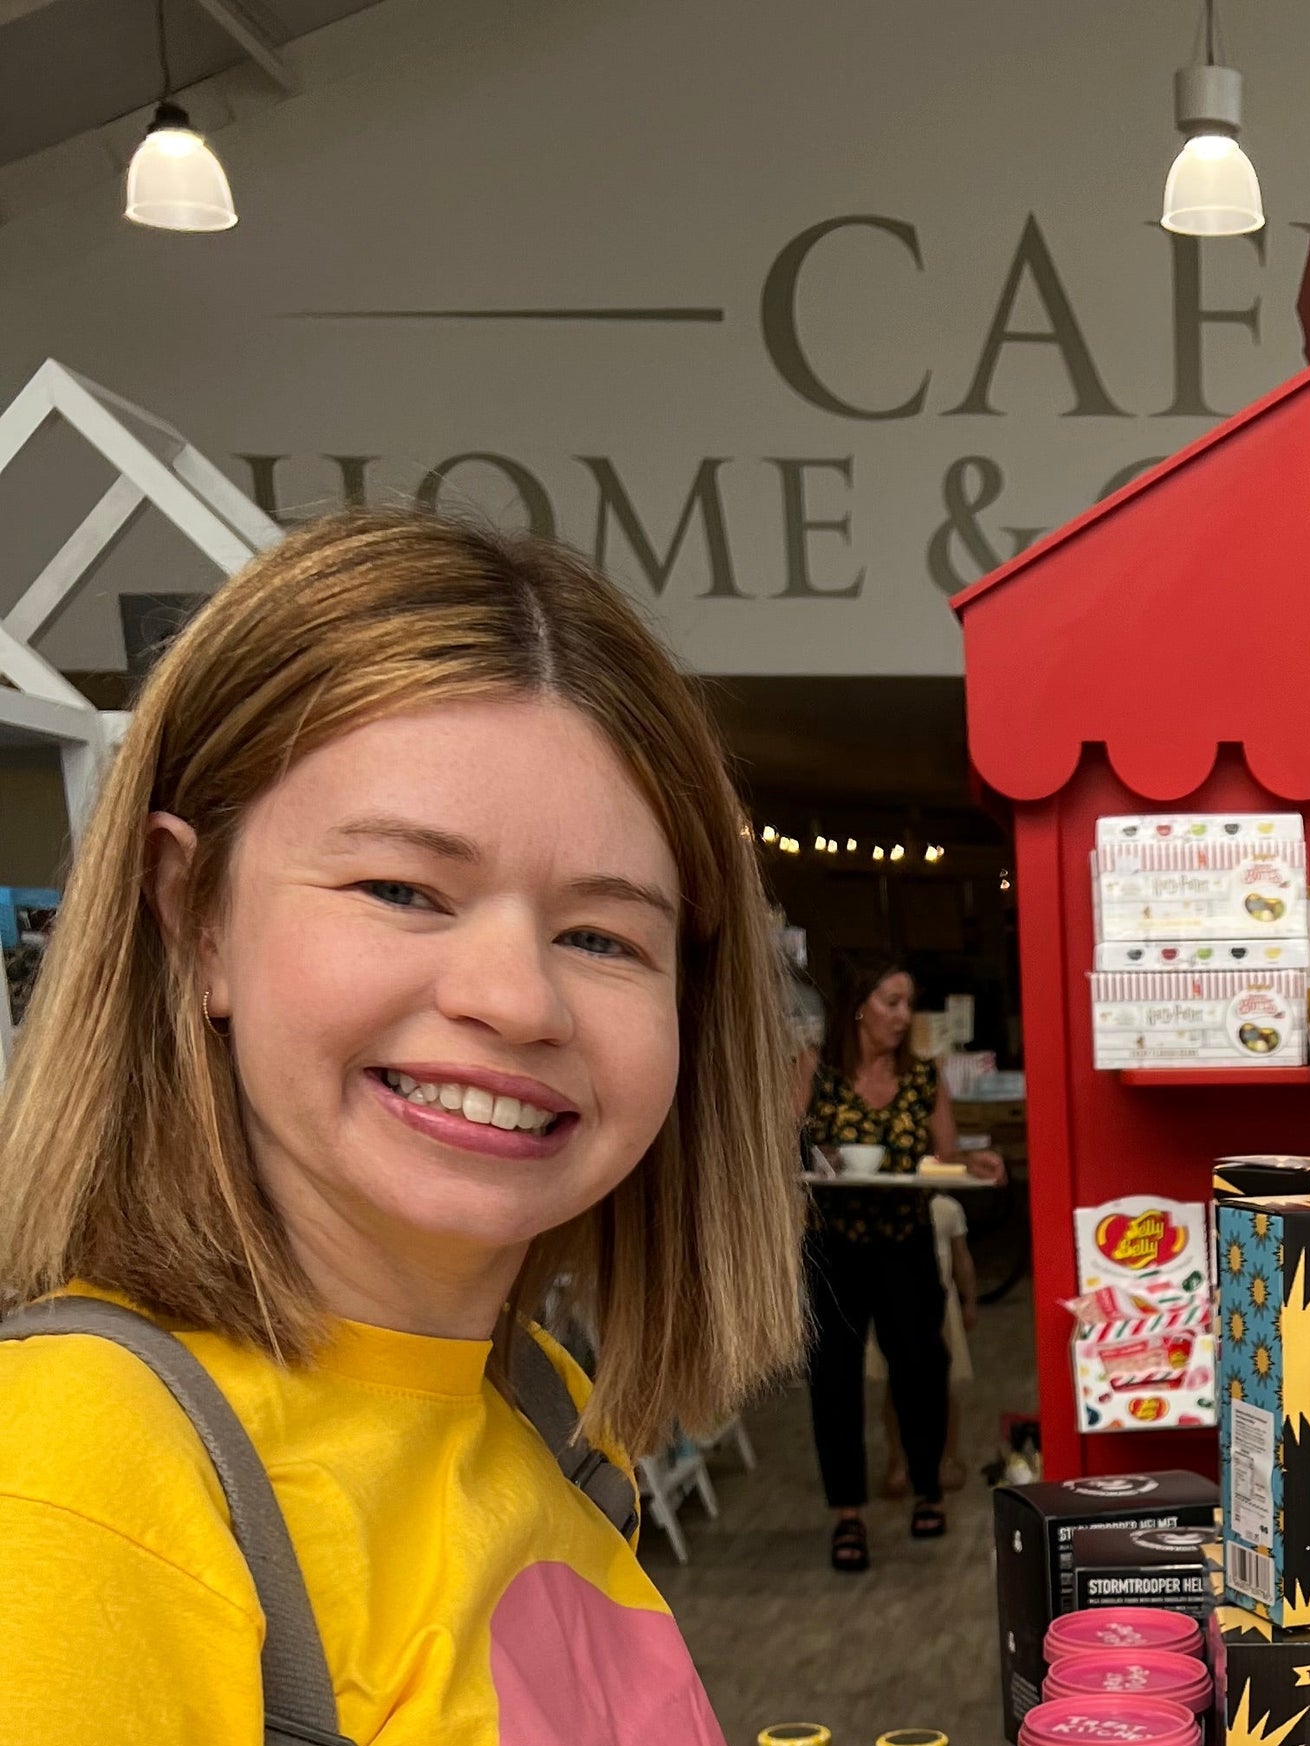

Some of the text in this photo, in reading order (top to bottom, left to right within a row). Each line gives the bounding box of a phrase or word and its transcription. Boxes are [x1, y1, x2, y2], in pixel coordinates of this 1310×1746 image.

[1088, 1577, 1203, 1595] STORMTROOPER HEL
[1066, 1715, 1147, 1732] TREAT
